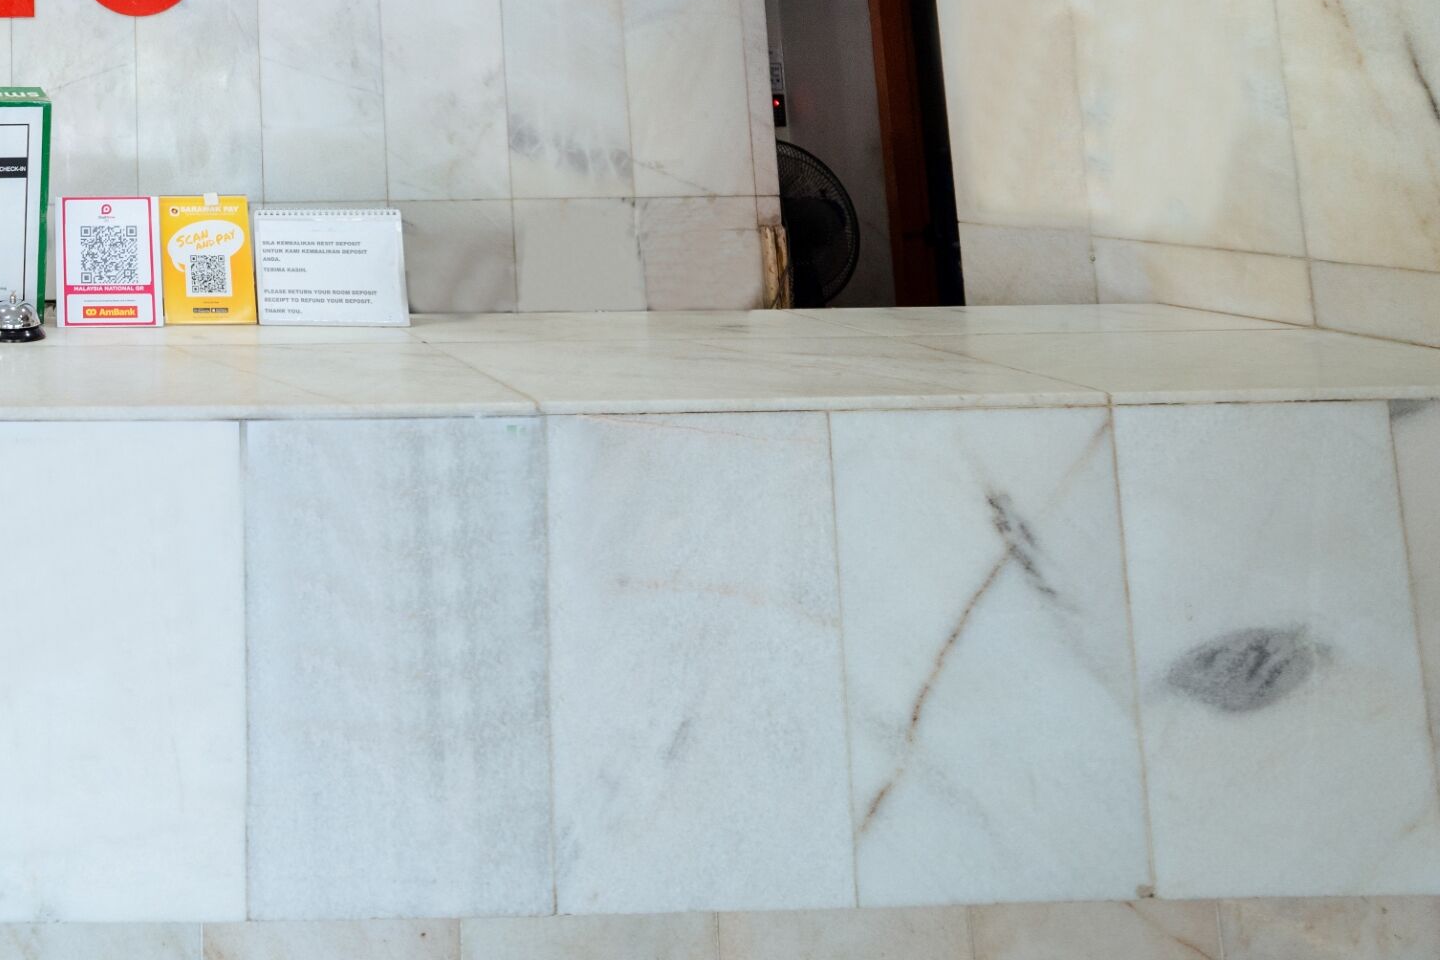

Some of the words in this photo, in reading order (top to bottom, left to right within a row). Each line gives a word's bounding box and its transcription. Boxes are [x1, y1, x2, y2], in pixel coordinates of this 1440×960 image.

[176, 228, 208, 248] SCAN
[196, 239, 215, 250] AND
[215, 230, 235, 244] PAY
[99, 308, 135, 316] AmBank
